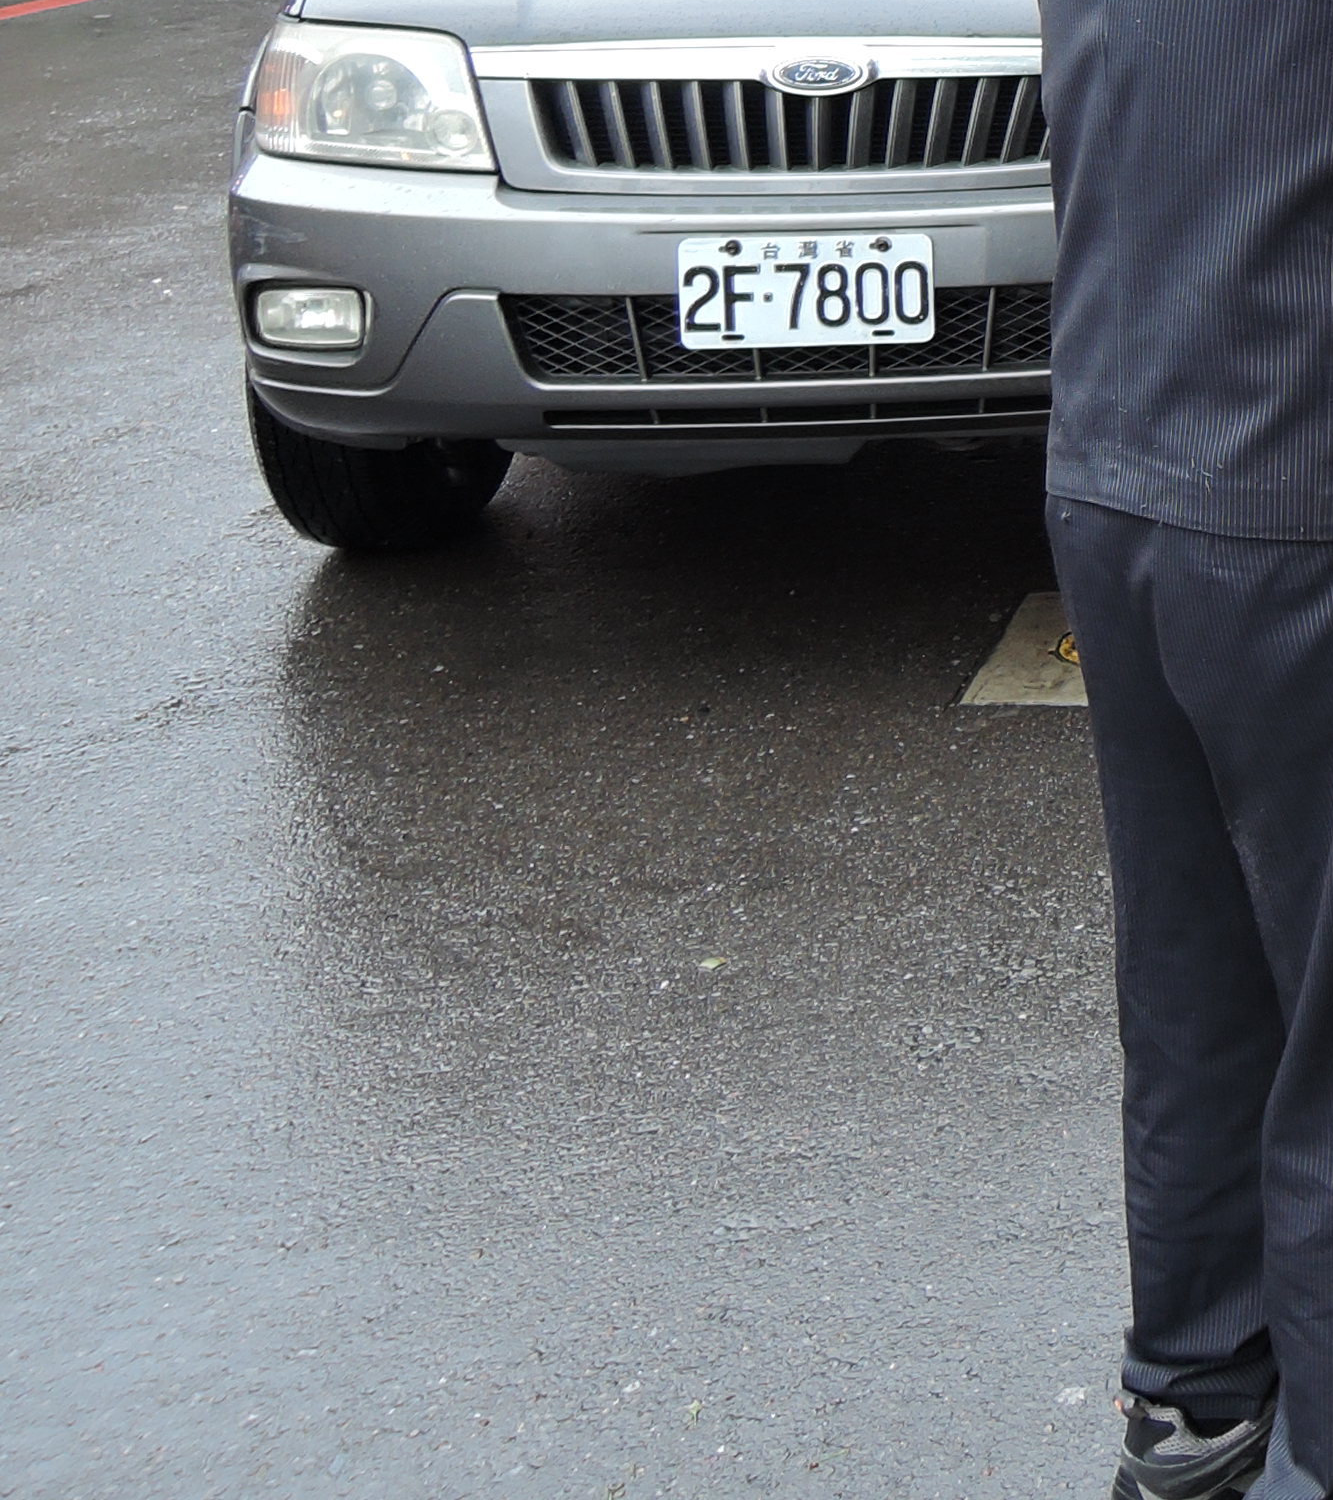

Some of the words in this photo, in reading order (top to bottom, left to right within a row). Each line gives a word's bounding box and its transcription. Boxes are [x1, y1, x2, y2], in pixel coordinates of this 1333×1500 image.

[794, 61, 840, 83] Ford
[760, 239, 856, 261] 台灣省
